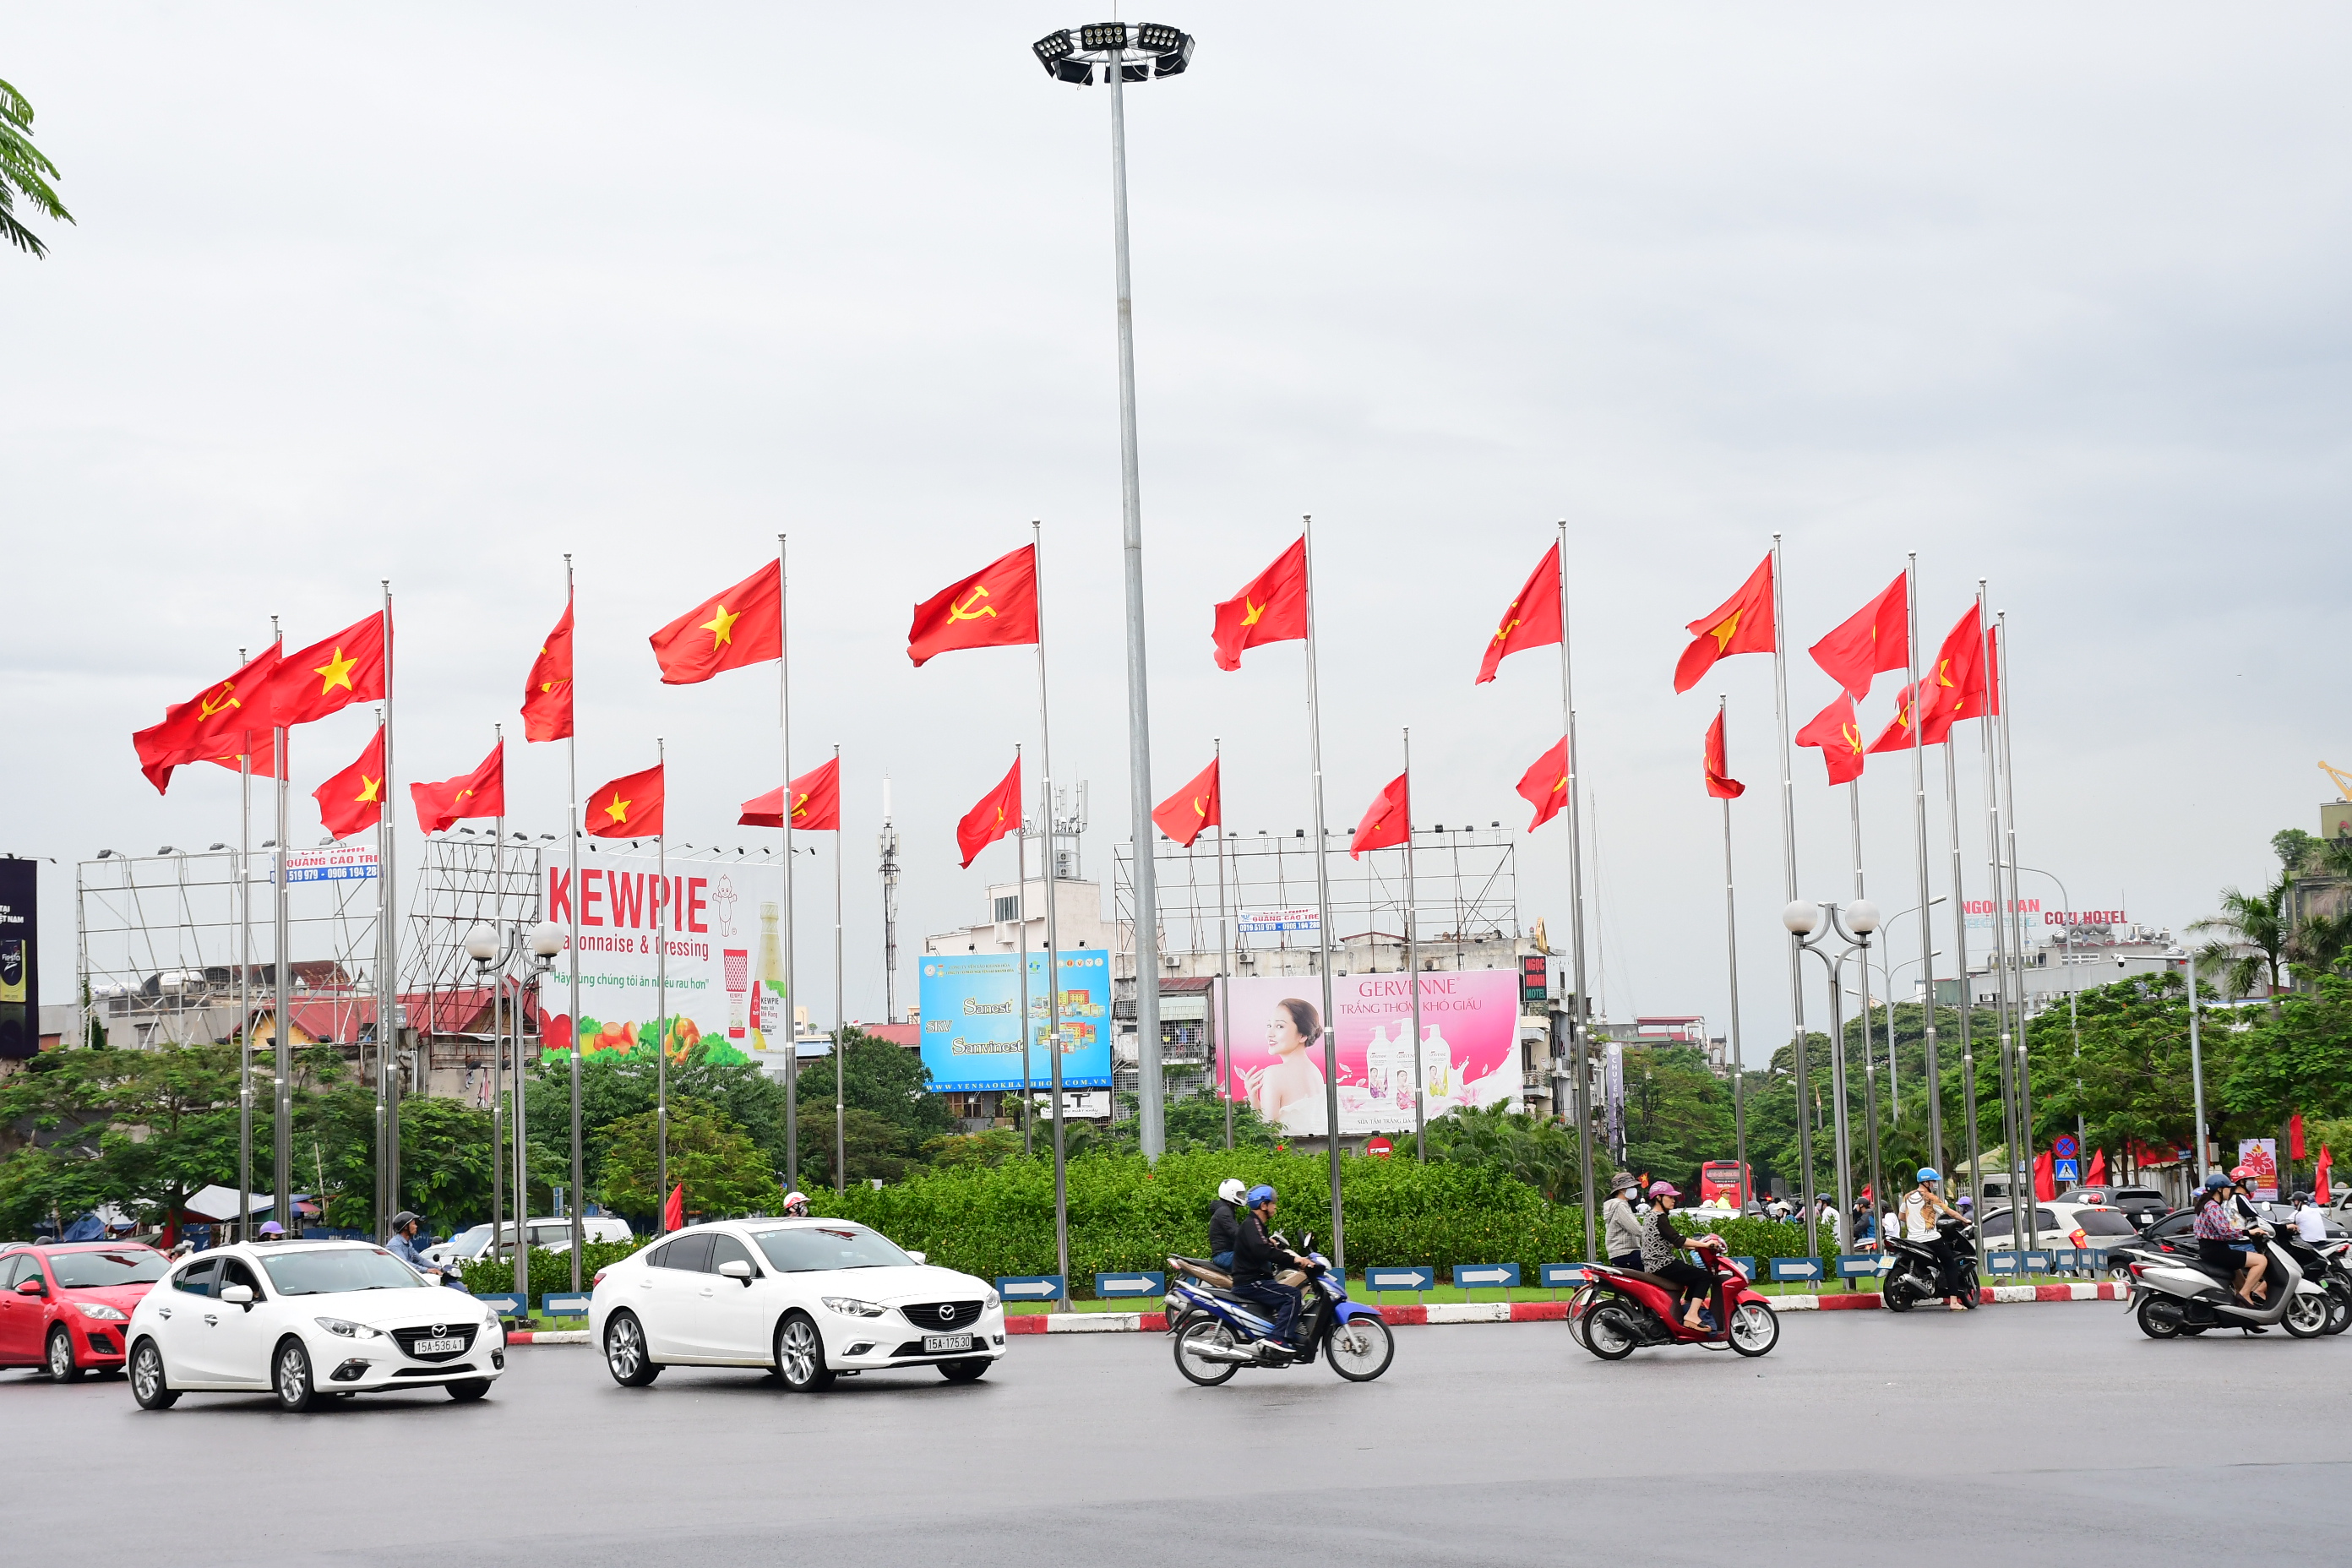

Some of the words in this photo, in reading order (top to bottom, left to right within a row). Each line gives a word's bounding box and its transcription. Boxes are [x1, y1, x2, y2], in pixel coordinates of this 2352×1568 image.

[289, 870, 302, 881] 519
[304, 869, 318, 879] 979
[327, 868, 347, 879] 0906
[349, 867, 364, 878] 194
[366, 866, 377, 877] 28
[549, 866, 708, 934] KEWPIE
[7, 915, 24, 923] NAM
[2082, 911, 2128, 925] HOTEL
[561, 933, 634, 953] aonnaise
[640, 939, 649, 954] &
[2, 952, 21, 961] Fiesta
[1525, 958, 1545, 972] NGỌC
[577, 972, 596, 988] ùng
[596, 972, 624, 988] chúng
[626, 974, 638, 987] tôi
[676, 980, 689, 988] rau
[1526, 974, 1545, 987] MINH
[1358, 978, 1457, 997] GERVENNE
[1526, 988, 1546, 999] MOTEL
[760, 997, 780, 1005] KEWPIE
[963, 997, 1012, 1015] Sanest
[1339, 999, 1380, 1015] TRẮNG
[1423, 999, 1450, 1012] KHÓ
[1453, 996, 1482, 1011] GIẤU
[925, 1020, 953, 1033] SKV
[952, 1037, 1023, 1055] Sanvinest
[925, 1078, 1108, 1091] WWW.YENSAOKHAHHO.COM.VN
[417, 1339, 463, 1353] 15A-536.41
[928, 1337, 970, 1349] 15A-175.30
